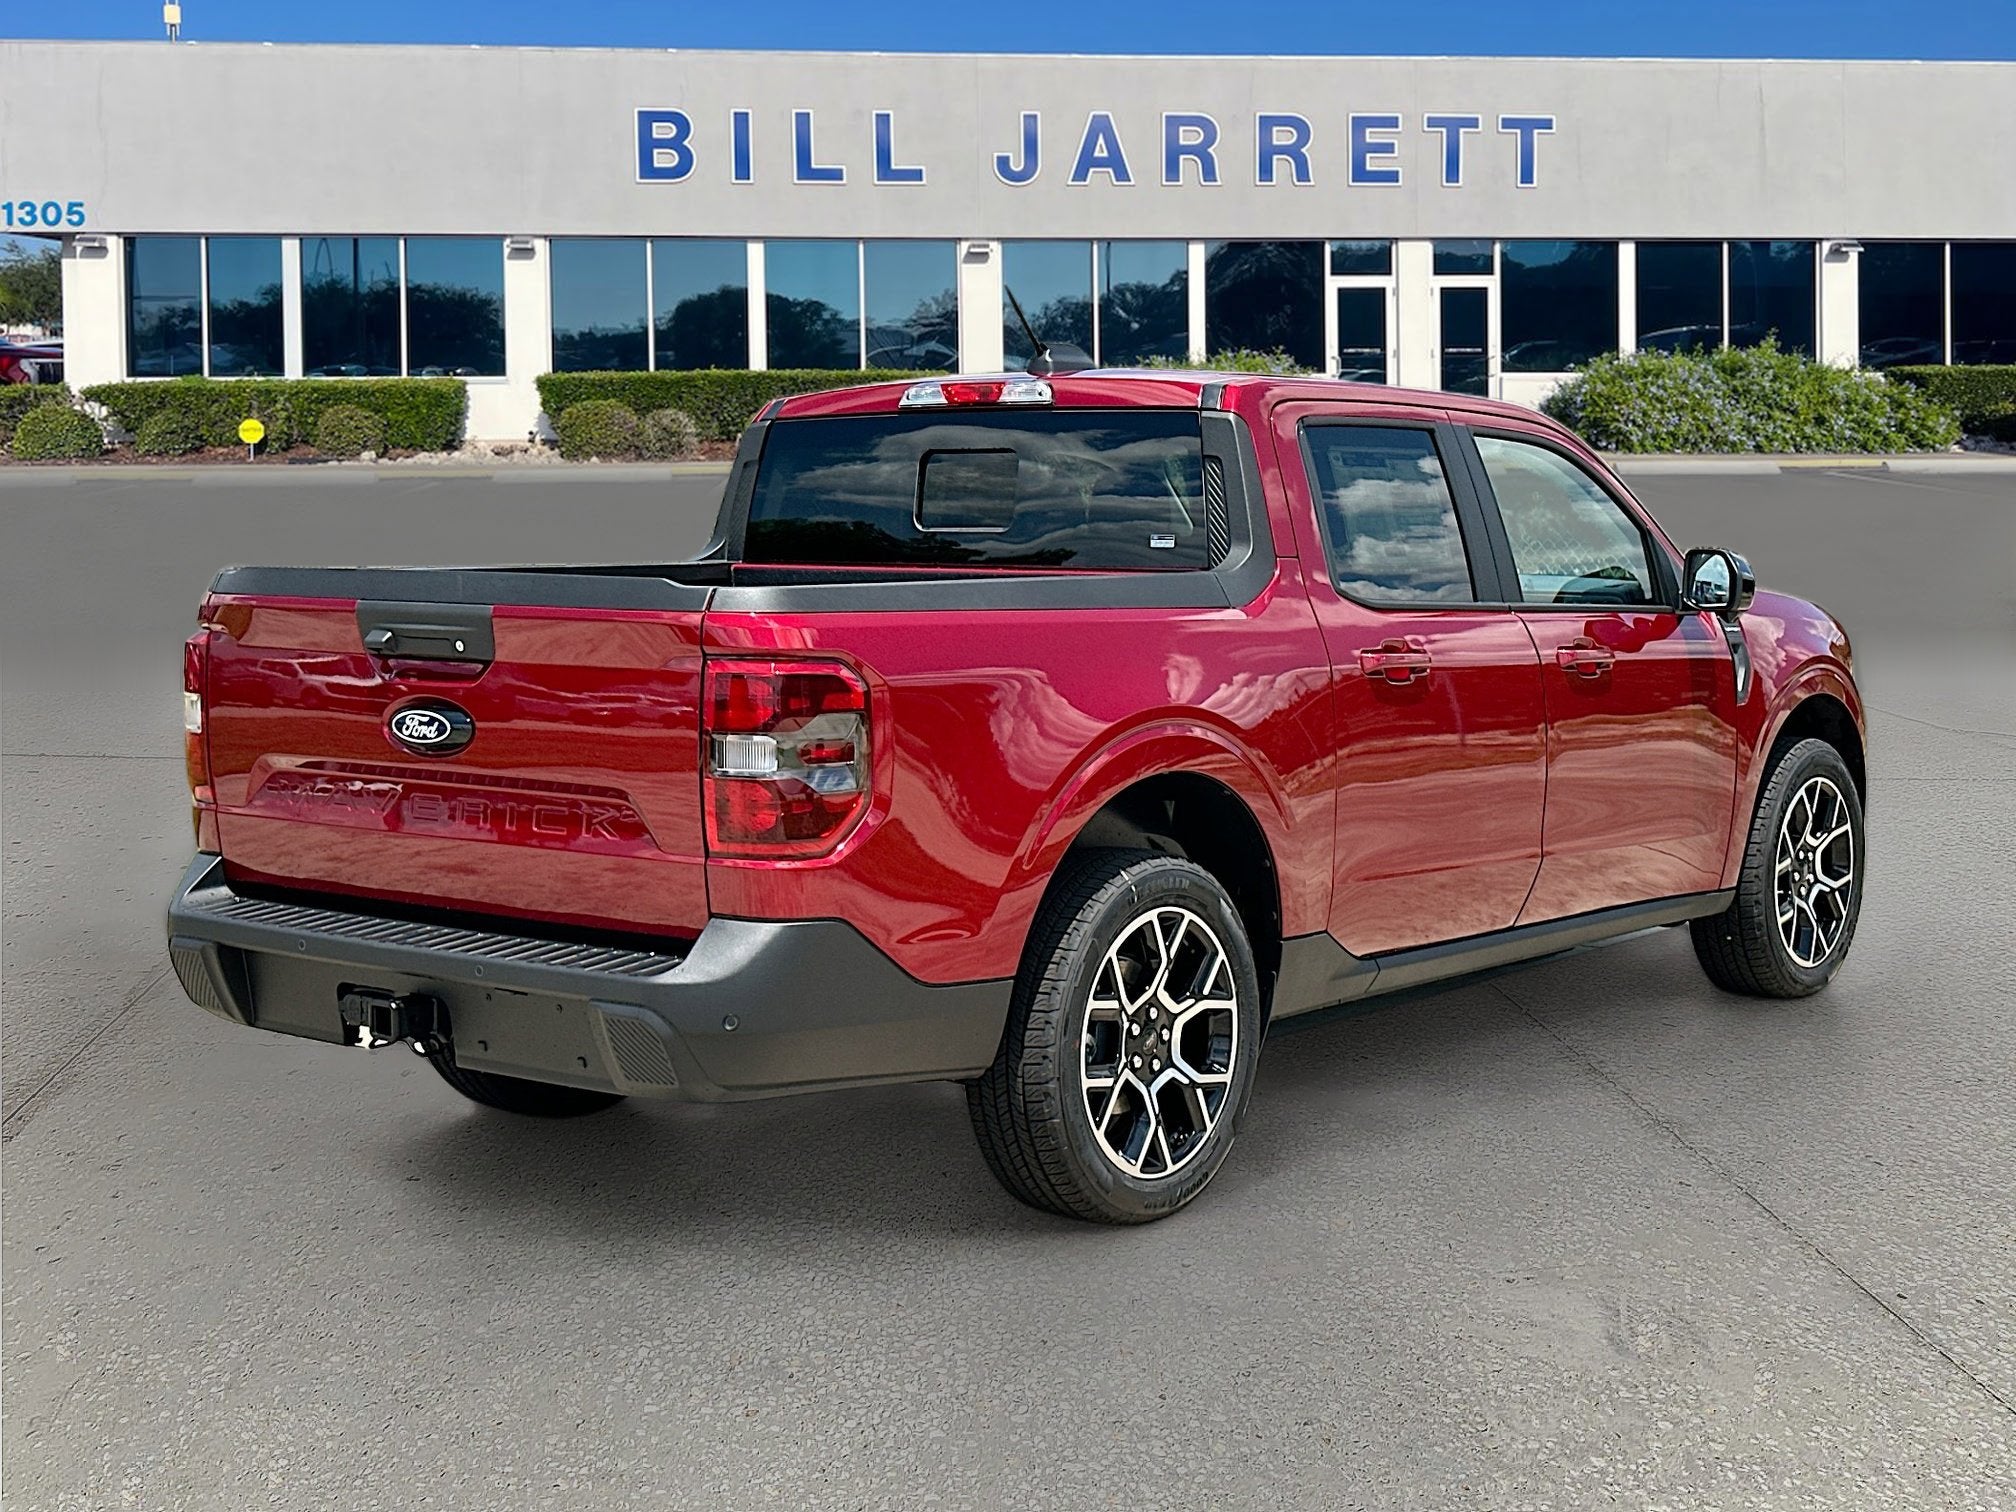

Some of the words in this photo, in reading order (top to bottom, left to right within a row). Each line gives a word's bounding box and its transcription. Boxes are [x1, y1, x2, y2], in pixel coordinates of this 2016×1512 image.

[634, 107, 926, 186] BILL
[993, 111, 1556, 188] JARRETT
[1, 200, 86, 227] 1305
[402, 714, 439, 738] Ford
[264, 778, 622, 841] MAVERICK
